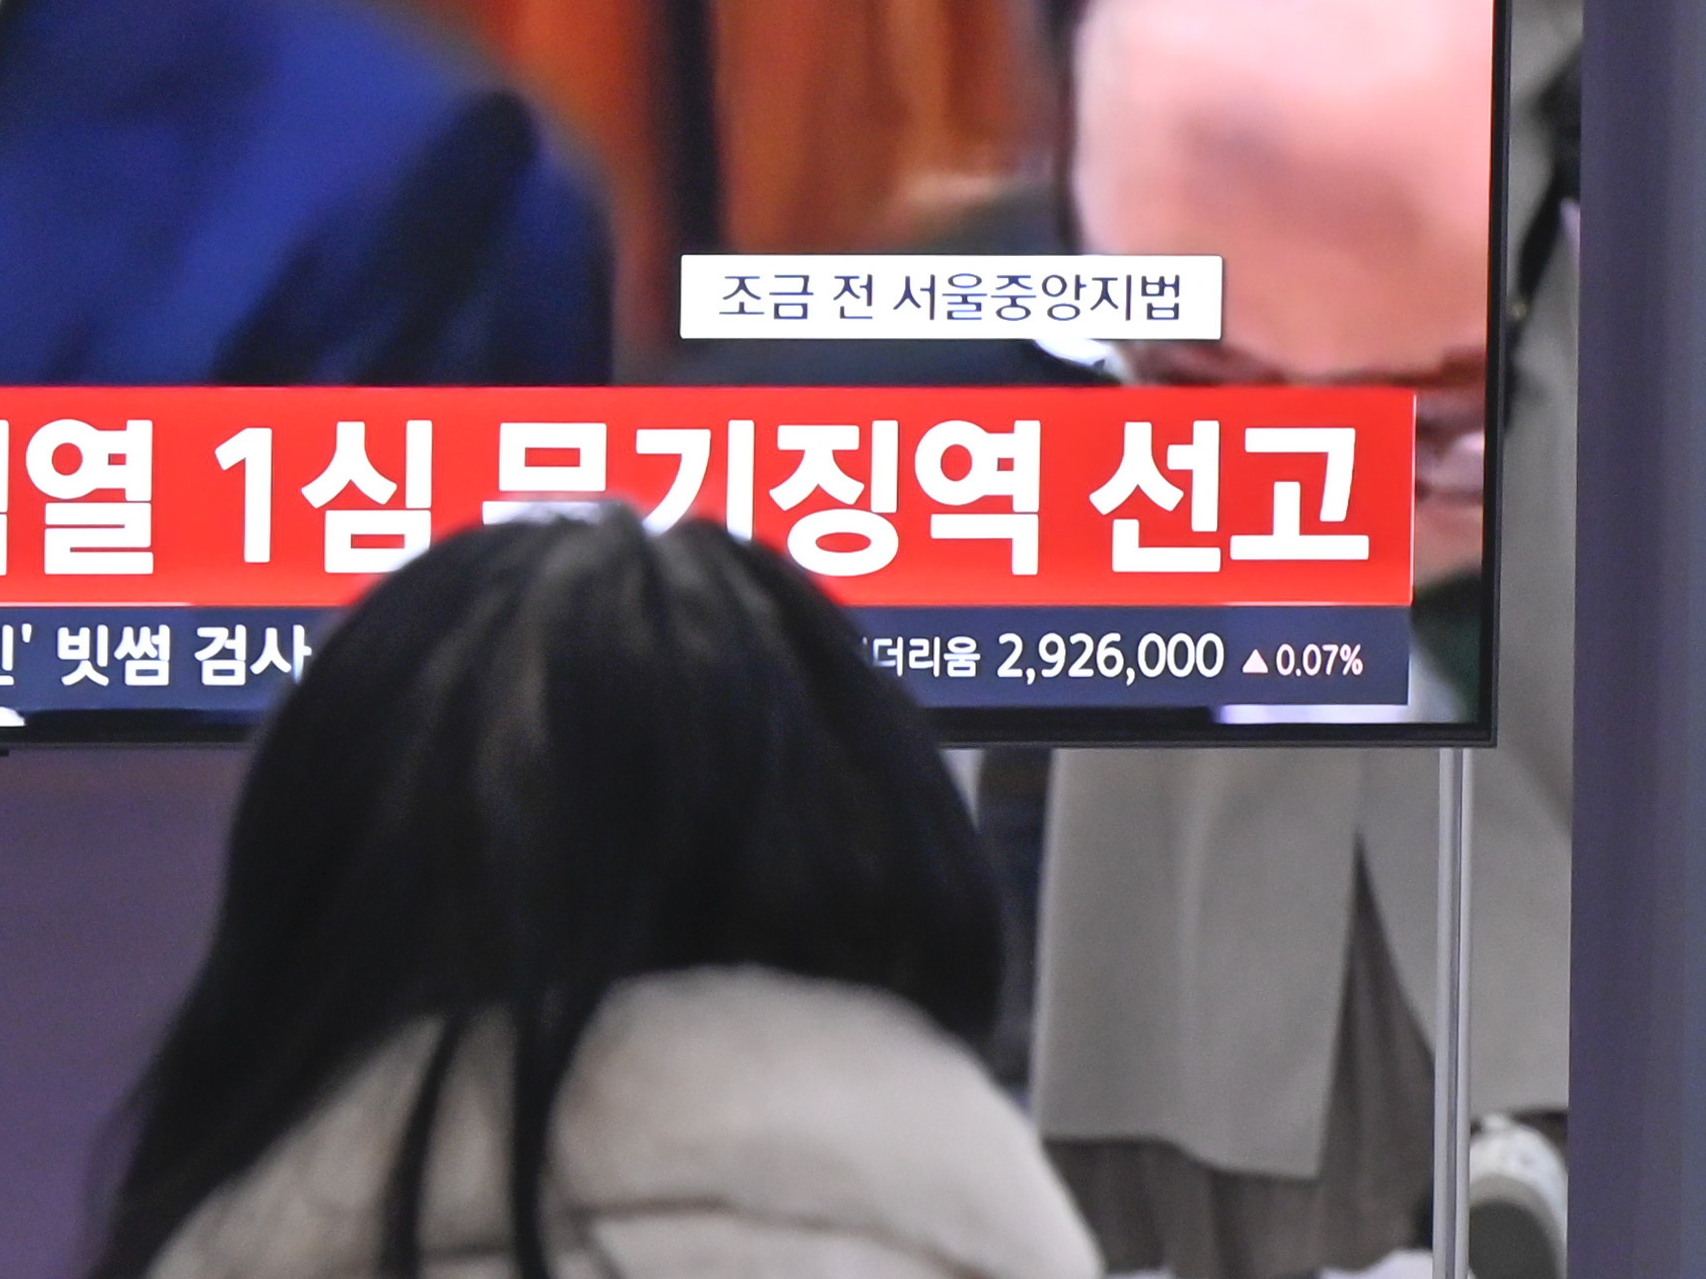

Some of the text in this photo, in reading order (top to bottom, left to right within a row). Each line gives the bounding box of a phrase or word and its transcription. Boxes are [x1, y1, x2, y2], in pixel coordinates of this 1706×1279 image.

[718, 272, 1182, 322] 조금 전 서울중앙지법
[213, 419, 434, 574] 1심
[1088, 420, 1371, 574] 선고
[56, 624, 171, 687] 빗썸
[193, 623, 313, 686] 검사
[863, 632, 1364, 687] 더리움 2,926,000 0.07%
